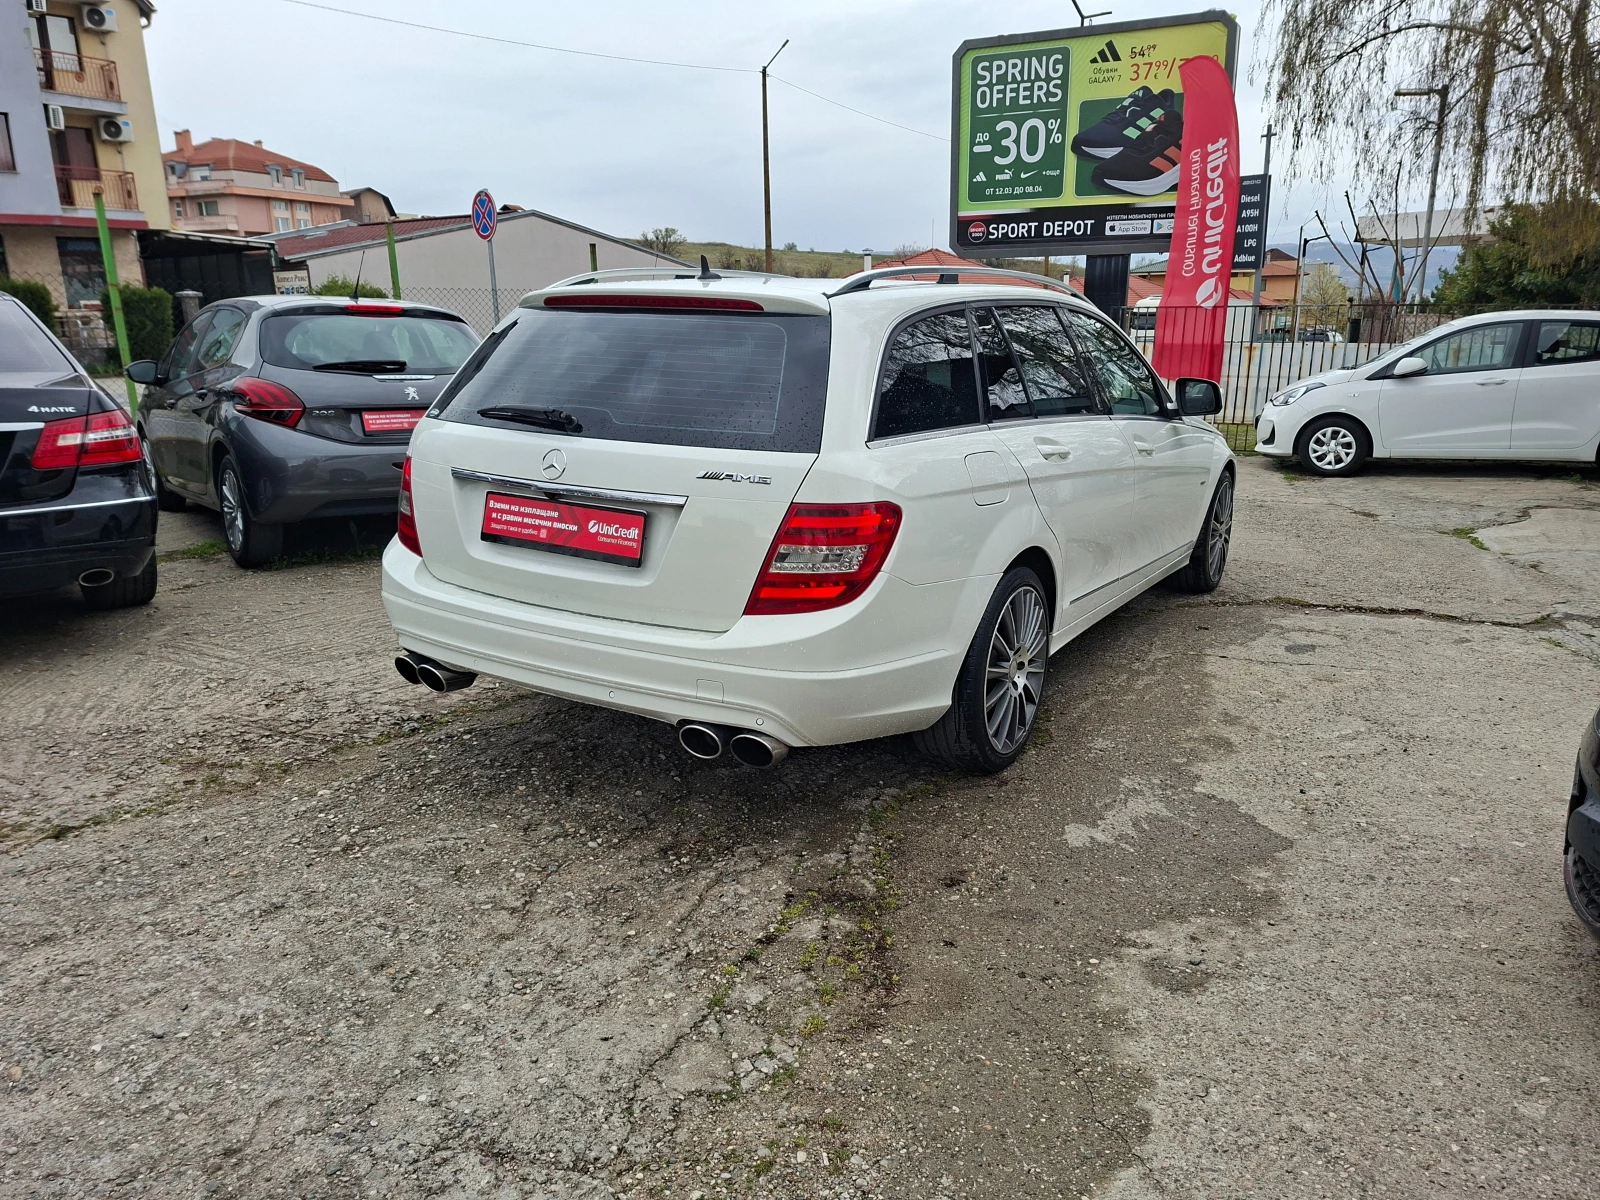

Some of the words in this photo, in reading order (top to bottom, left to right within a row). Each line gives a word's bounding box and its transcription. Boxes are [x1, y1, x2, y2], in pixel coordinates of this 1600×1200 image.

[977, 54, 1063, 85] SPRING
[1093, 67, 1118, 76] Обувки
[1088, 75, 1115, 84] GALAXY
[1117, 74, 1122, 82] 7
[976, 79, 1062, 108] OFFERS
[995, 187, 1012, 195] 12.03
[1013, 186, 1024, 195] ДО
[1025, 185, 1042, 193] 08.04
[1240, 193, 1260, 203] Diesel
[1241, 208, 1259, 218] A95H
[988, 222, 1039, 239] SPORT
[1042, 219, 1095, 237] DEPOT
[1236, 224, 1258, 233] A100H
[1244, 238, 1257, 247] LPG
[1234, 253, 1255, 262] Adblue
[489, 500, 510, 510] Вземи
[519, 506, 559, 518] изплащане
[502, 513, 523, 523] равни
[523, 517, 552, 528] месечни
[552, 521, 578, 532] вноски
[598, 522, 639, 539] UniCredit
[597, 535, 618, 544] Consumer
[617, 538, 638, 549] Financing
